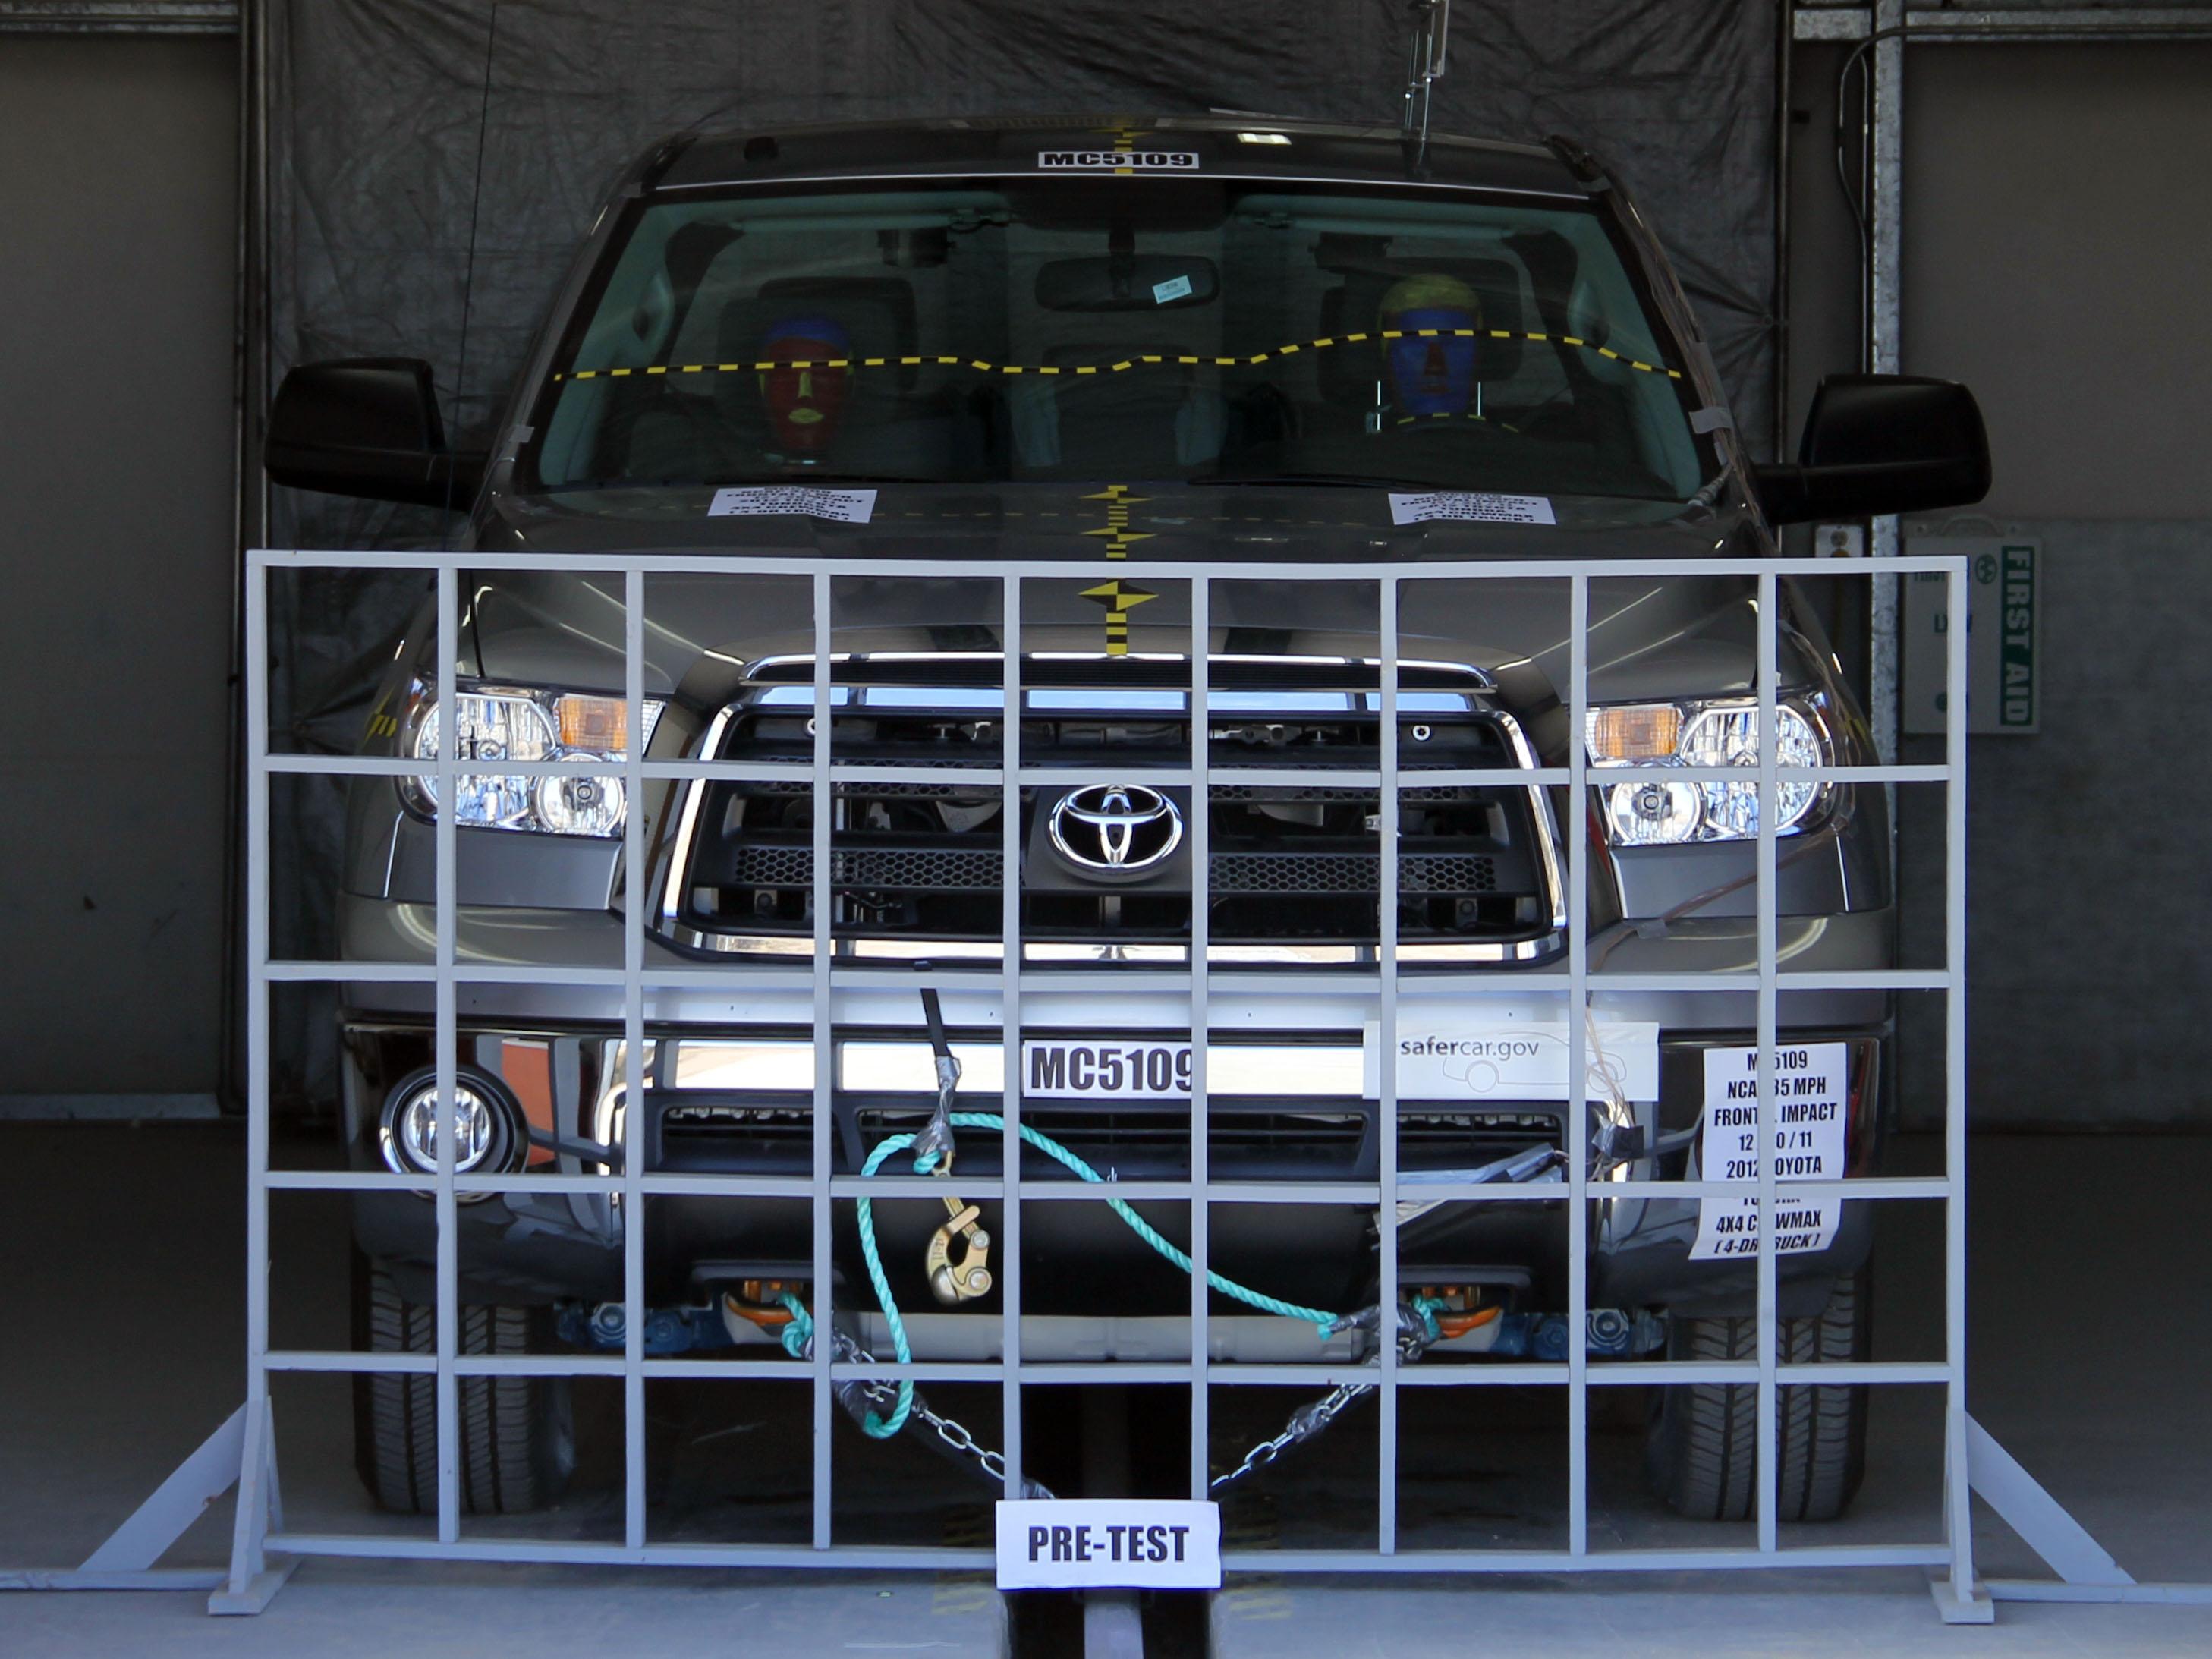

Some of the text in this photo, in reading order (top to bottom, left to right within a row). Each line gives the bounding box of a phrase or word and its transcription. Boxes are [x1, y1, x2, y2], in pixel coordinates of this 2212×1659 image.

[1044, 152, 1193, 166] MC5109
[2006, 550, 2031, 723] FIRST AID
[1400, 1035, 1540, 1061] safercar.gov
[1032, 1047, 1191, 1091] MC5109
[1747, 1050, 1808, 1072] M5109
[1727, 1081, 1760, 1099] NCA
[1794, 1076, 1827, 1096] MPH
[1714, 1102, 1838, 1127] FRONT IMPACT
[1738, 1134, 1754, 1151] 12
[1800, 1130, 1812, 1149] 11
[1773, 1155, 1823, 1176] OYOTA
[1716, 1210, 1822, 1234] 4X4 CWMAX
[1772, 1233, 1812, 1251] RUCK
[1028, 1525, 1190, 1562] PRE-TEST
